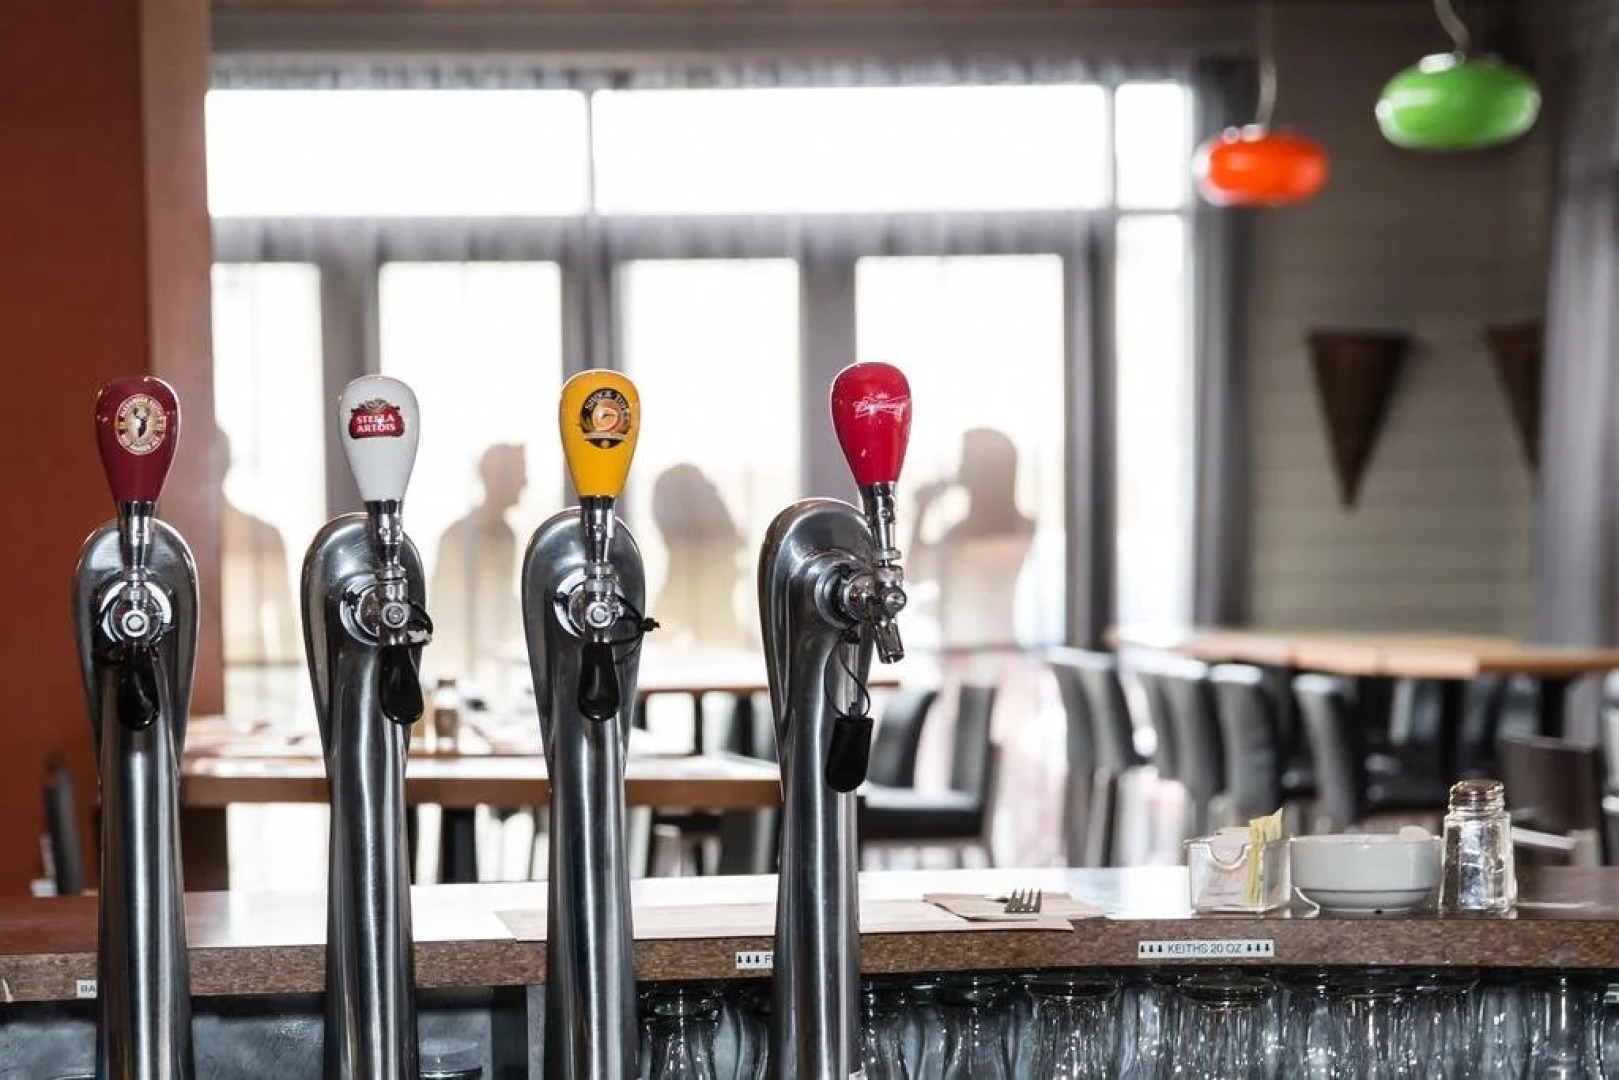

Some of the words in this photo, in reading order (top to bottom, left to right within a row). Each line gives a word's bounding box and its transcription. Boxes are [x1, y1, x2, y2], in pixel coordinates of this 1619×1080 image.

[356, 413, 395, 424] STELLA
[356, 423, 396, 433] ARTOIS
[1167, 943, 1208, 954] KEITHS
[1210, 943, 1224, 954] 20
[1226, 943, 1242, 954] OZ
